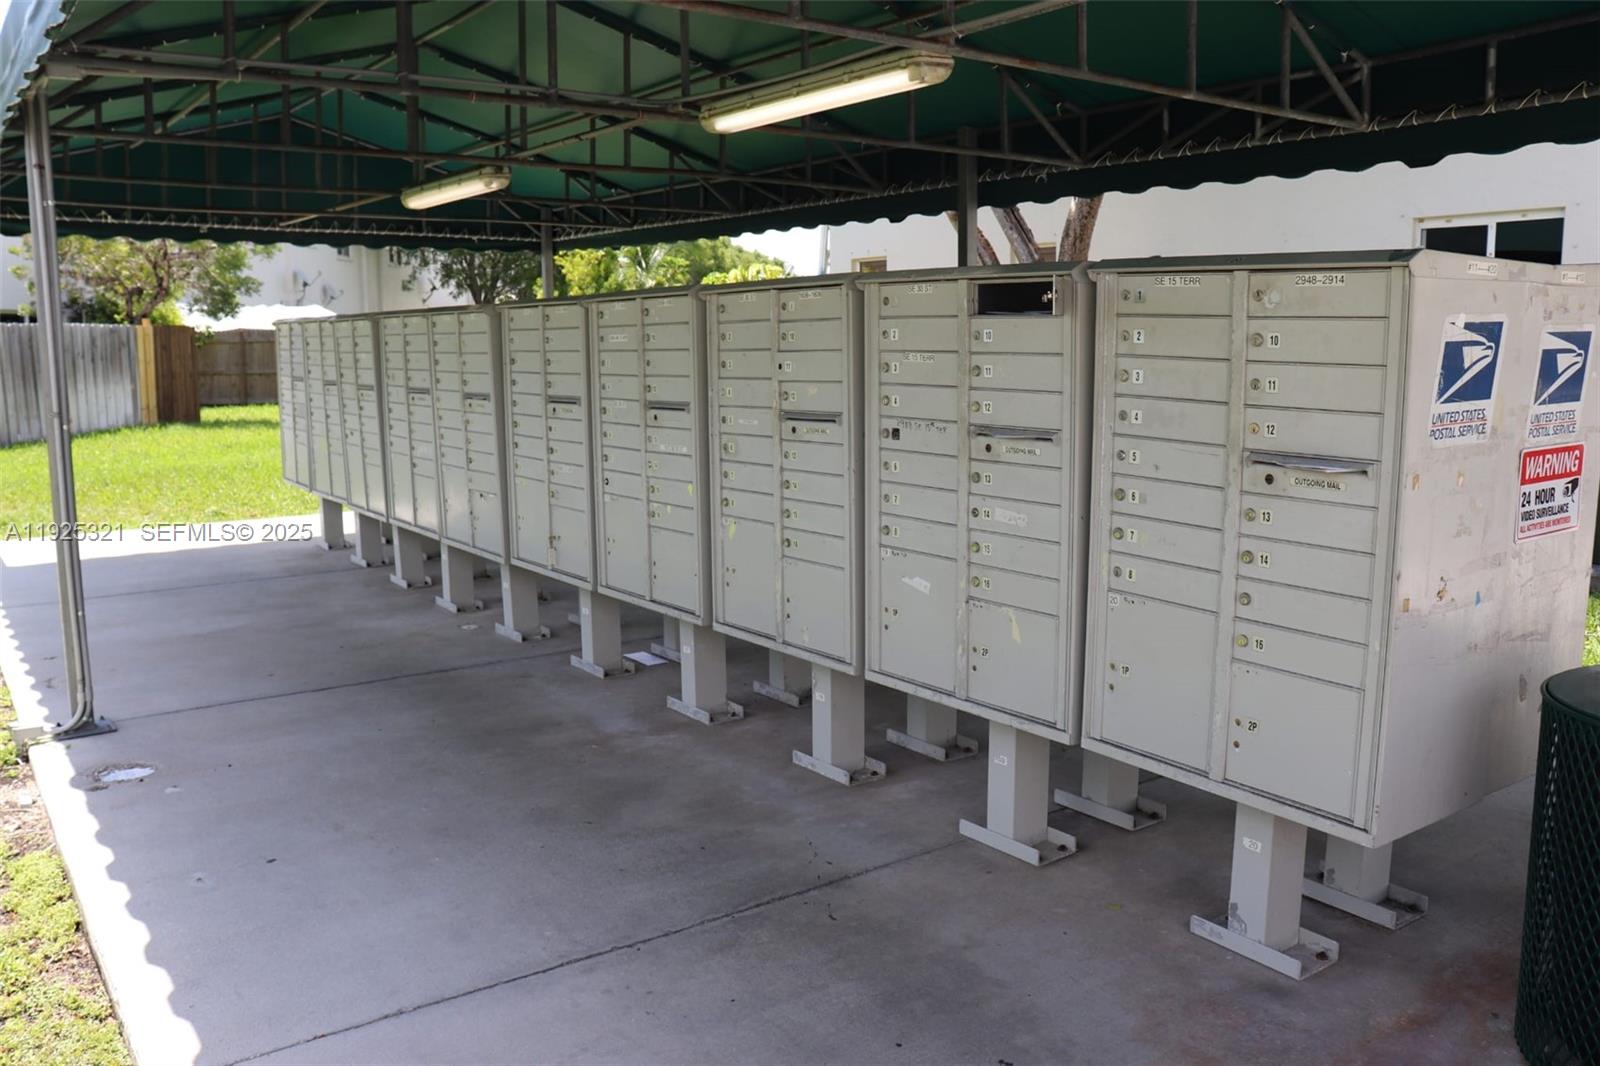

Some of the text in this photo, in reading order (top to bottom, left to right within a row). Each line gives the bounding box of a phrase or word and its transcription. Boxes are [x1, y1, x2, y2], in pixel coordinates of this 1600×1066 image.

[1154, 277, 1200, 285] SE 15 TERR
[1295, 275, 1344, 285] 2948-2914
[1270, 335, 1279, 346] 10
[1268, 380, 1276, 390] 11
[984, 402, 991, 412] 12
[1432, 408, 1486, 424] UNITED STATES
[1530, 410, 1576, 424] UNITED STATES
[1266, 425, 1275, 435] 12
[1430, 424, 1486, 440] POSTAL SERVICE
[1528, 423, 1576, 438] POSTAL SERVICE
[1525, 450, 1580, 480] WARNING
[1294, 477, 1341, 490] OUTGOING MAIL
[1521, 487, 1556, 508] 24 HOUR
[1262, 512, 1271, 522] 13
[1521, 503, 1569, 522] VIDEO SURVEILLANCE
[1260, 555, 1268, 565] 14
[1121, 666, 1130, 675] 1P
[1248, 721, 1257, 731] 2P
